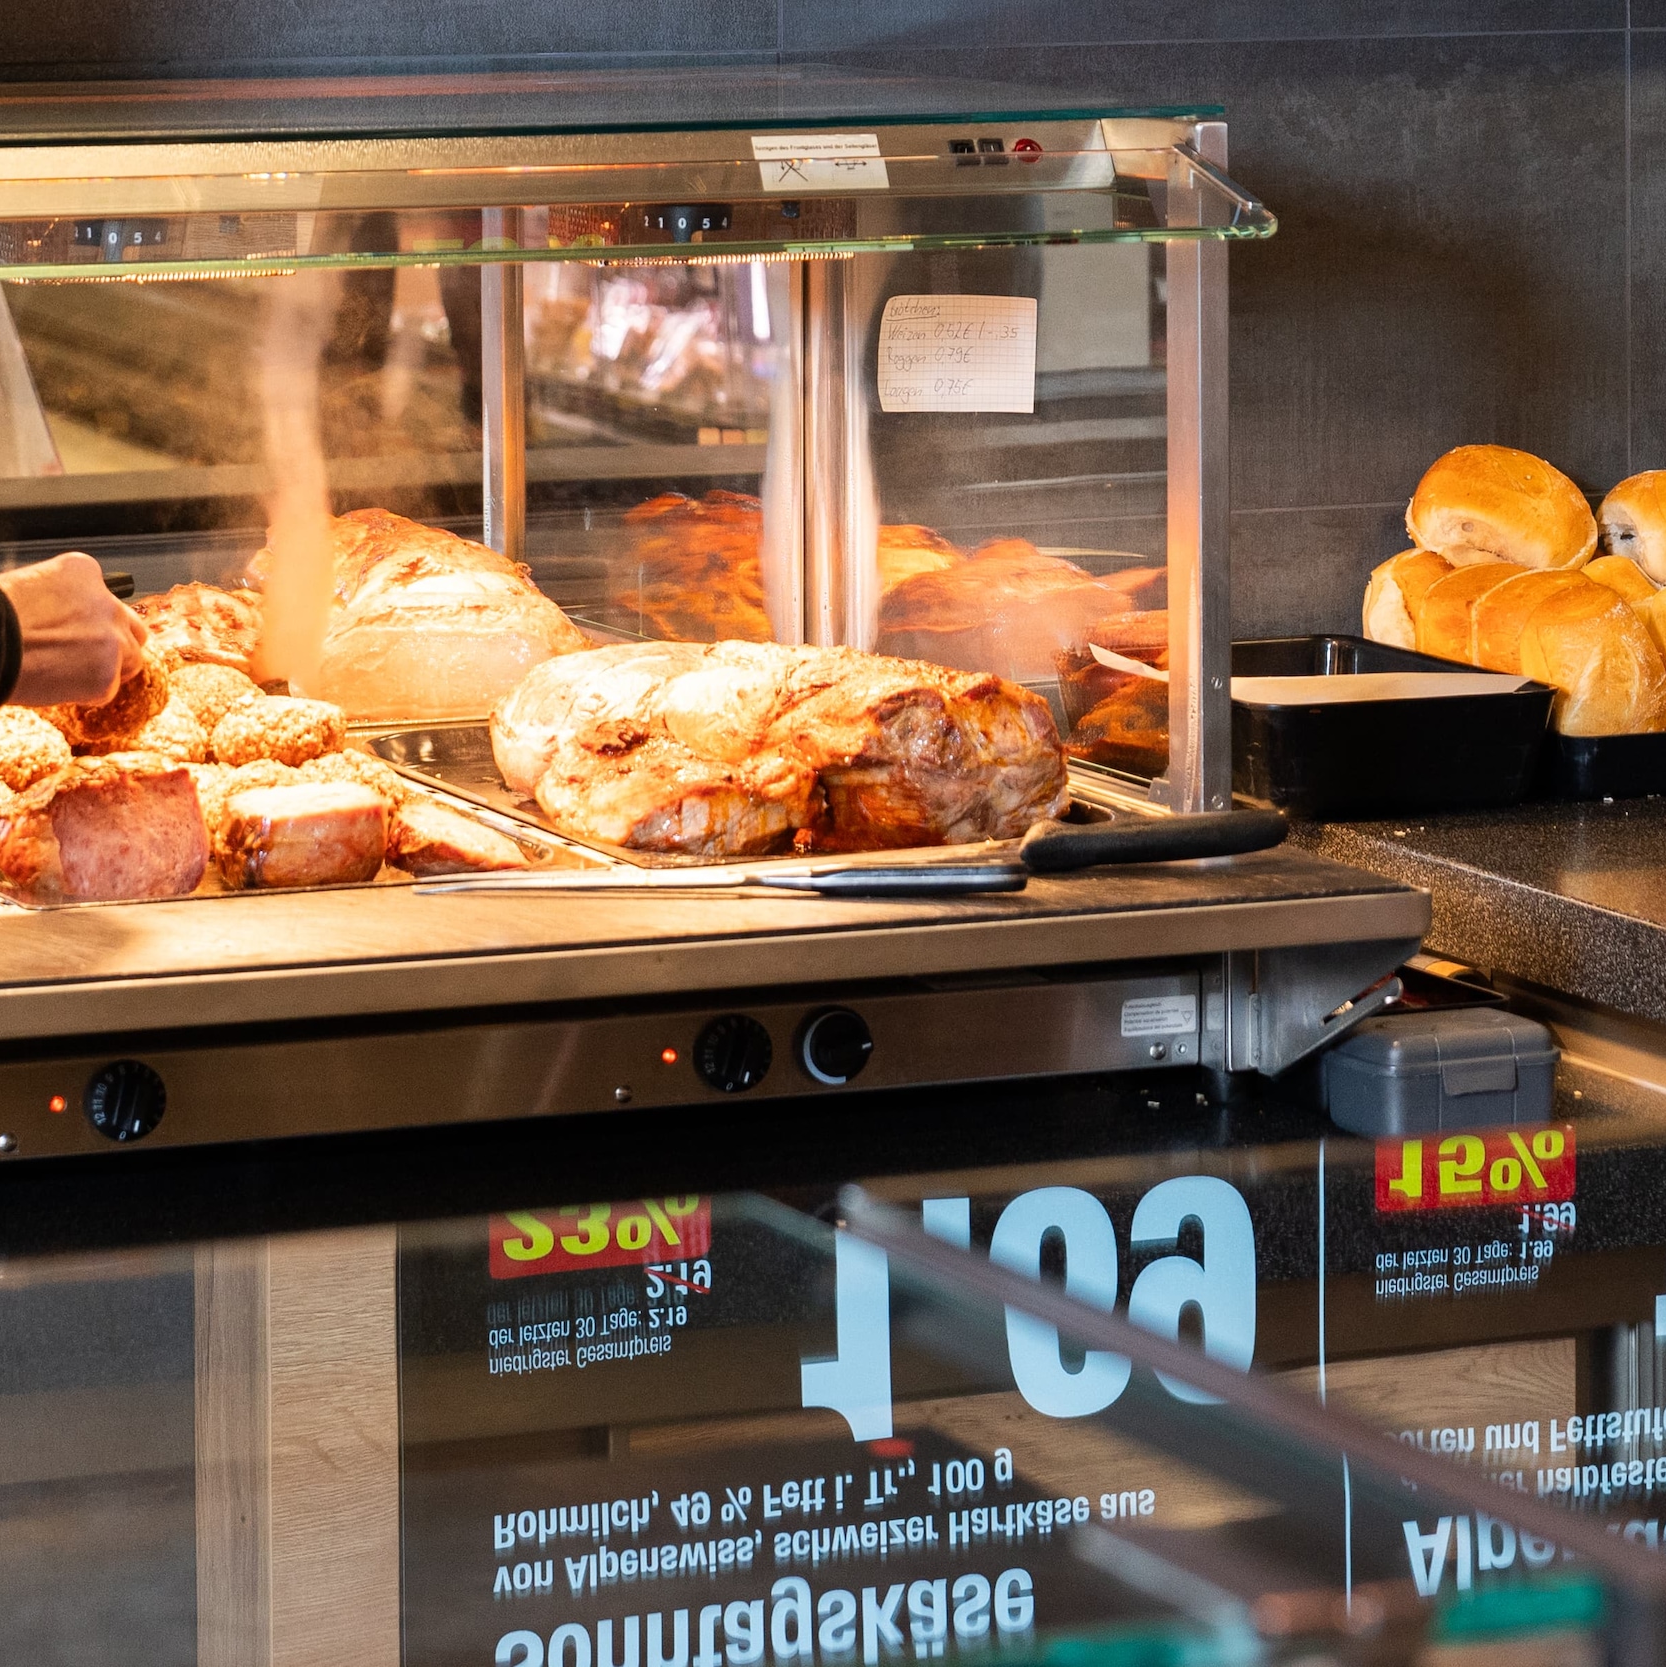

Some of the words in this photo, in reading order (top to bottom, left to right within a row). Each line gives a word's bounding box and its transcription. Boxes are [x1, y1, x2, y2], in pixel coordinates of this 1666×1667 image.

[658, 216, 664, 229] 1
[677, 217, 687, 229] 0
[702, 217, 711, 229] 5
[108, 232, 118, 244] 0
[134, 231, 143, 244] 5
